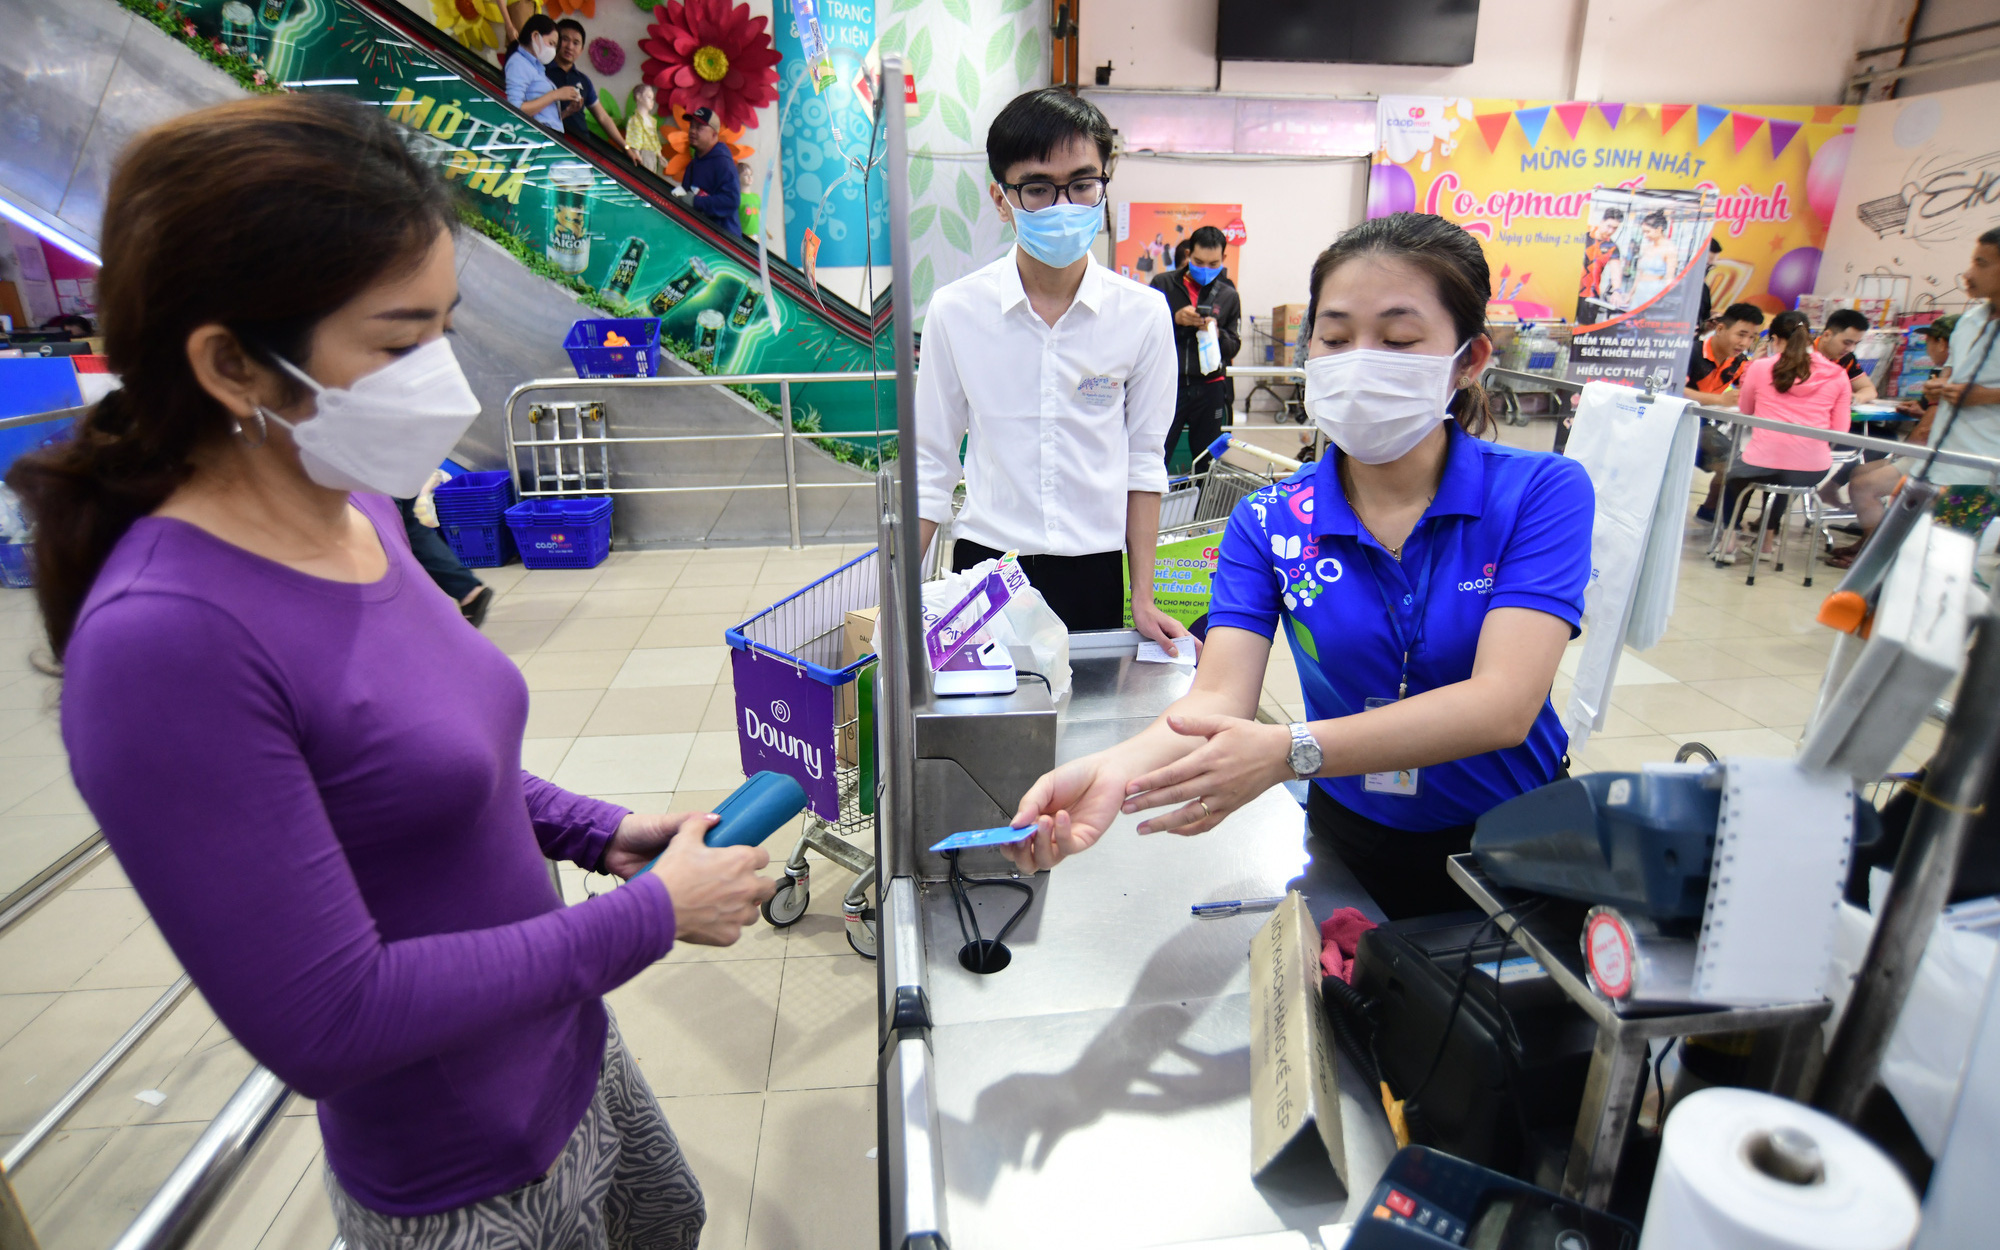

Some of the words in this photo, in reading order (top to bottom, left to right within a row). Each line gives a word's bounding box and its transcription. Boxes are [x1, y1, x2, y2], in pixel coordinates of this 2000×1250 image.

[826, 1, 871, 24] TRANG
[840, 26, 868, 48] KIỆN
[388, 86, 470, 140] MỞ
[463, 116, 543, 168] TẾT
[445, 150, 531, 205] PHÁ
[1521, 147, 1587, 173] MỪNG
[1594, 148, 1642, 170] SINH
[1647, 151, 1706, 180] NHẬT
[1535, 232, 1561, 247] tháng
[1564, 234, 1571, 244] 2
[1573, 332, 1598, 346] KIỂM
[1599, 336, 1619, 346] TRA
[1620, 337, 1635, 347] ĐO
[1637, 336, 1650, 347] VÀ
[1653, 338, 1667, 348] TƯ
[1667, 336, 1690, 349] VẤN
[1581, 346, 1600, 357] SỨC
[1602, 346, 1629, 358] KHỎE
[1631, 347, 1657, 359] MIỄN
[1658, 349, 1677, 359] PHÍ
[1576, 364, 1603, 376] HIỂU
[1604, 366, 1623, 377] CƠ
[1623, 364, 1647, 378] THỂ
[1154, 568, 1170, 579] HẺ
[1171, 570, 1192, 580] ACB
[1185, 582, 1207, 594] ĐẾN
[744, 706, 823, 780] Downy
[1270, 913, 1283, 944] MỜI
[1271, 944, 1286, 1001] KHÁCH
[1275, 1000, 1289, 1055] HÀNG
[1275, 1053, 1292, 1086] KẾ
[1276, 1083, 1293, 1131] TIẾP
